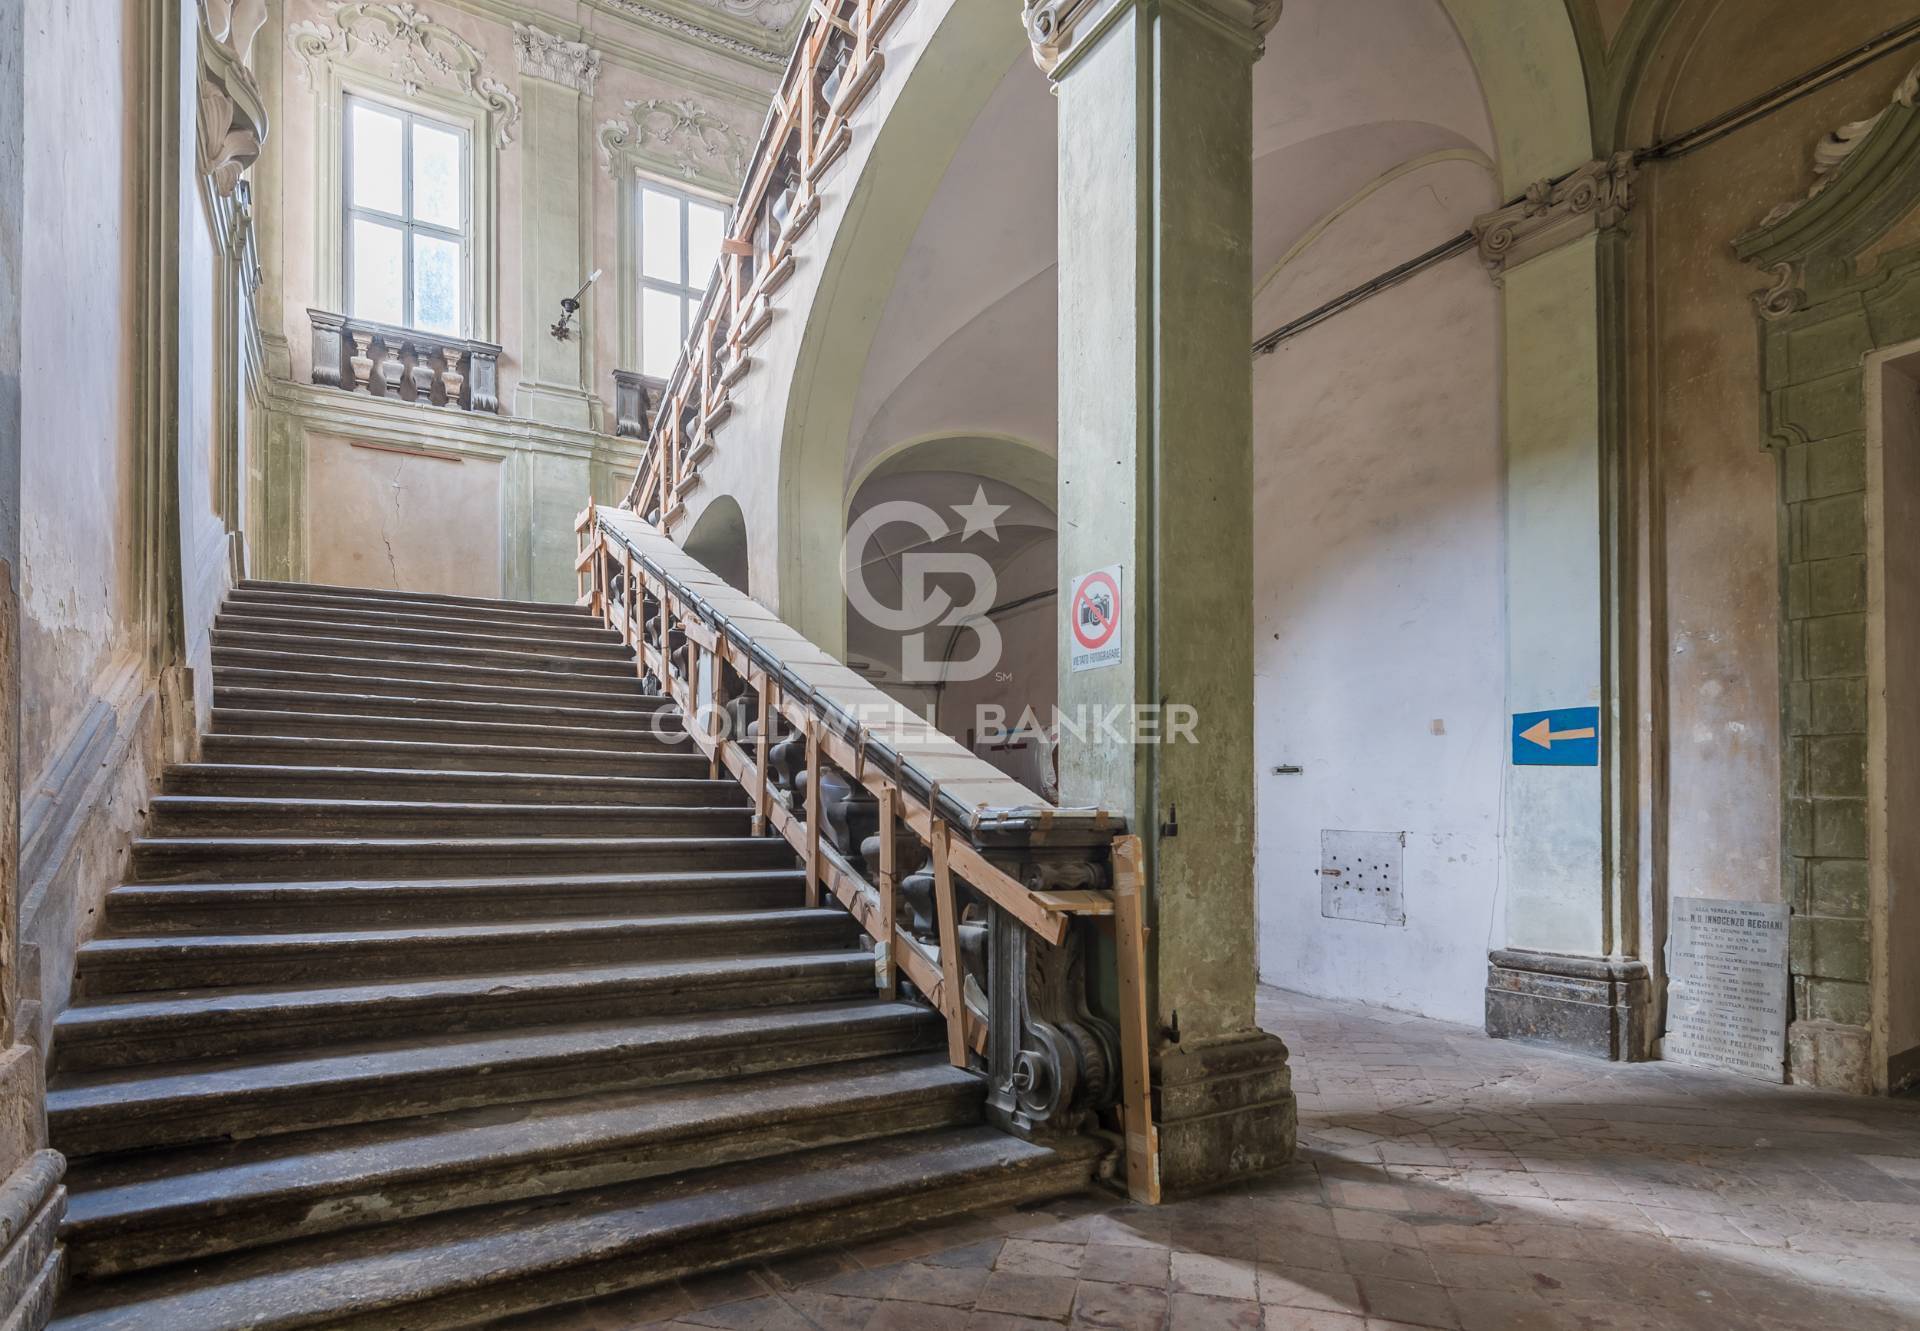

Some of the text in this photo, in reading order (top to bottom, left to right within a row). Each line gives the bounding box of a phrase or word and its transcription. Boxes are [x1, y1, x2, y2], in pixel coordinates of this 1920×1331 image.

[1072, 654, 1088, 666] VIETATO
[1705, 914, 1744, 927] INNOCENZO
[1747, 918, 1783, 930] REGGIANI
[1730, 1039, 1772, 1052] PELLEGRINI
[1671, 1046, 1691, 1055] MARIA
[1725, 1056, 1748, 1066] PIETRO
[1750, 1060, 1774, 1071] ROSINA
